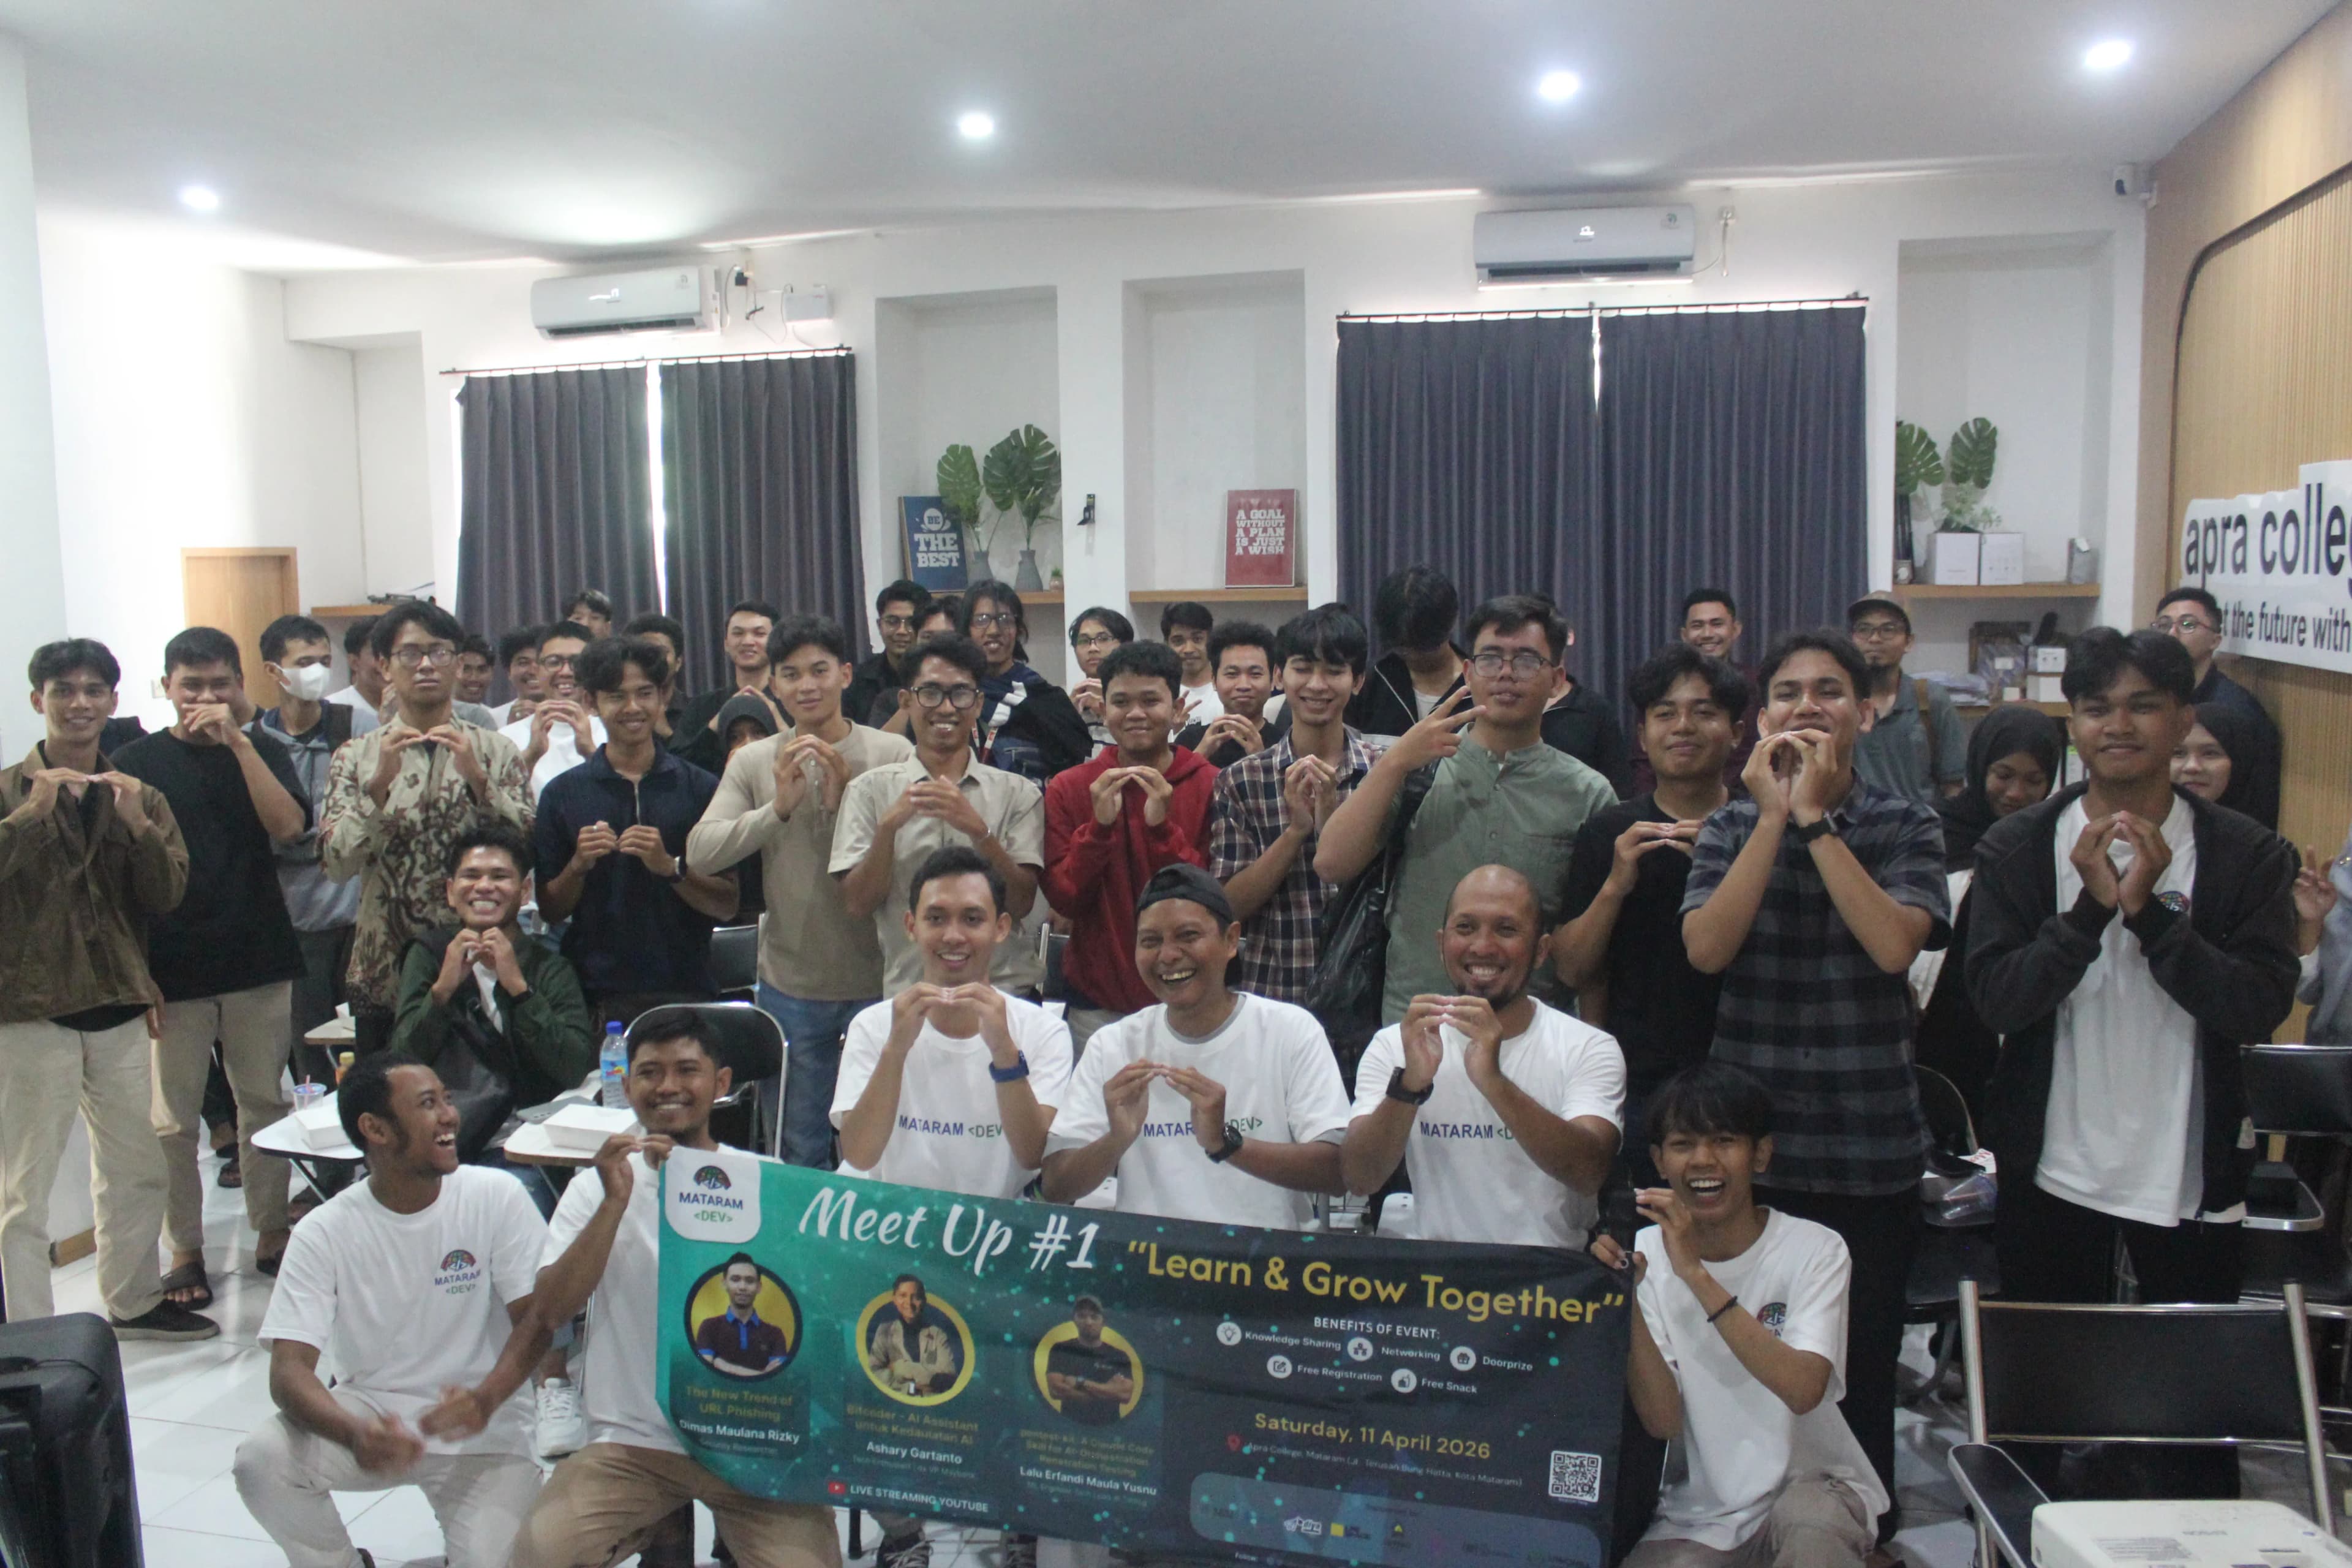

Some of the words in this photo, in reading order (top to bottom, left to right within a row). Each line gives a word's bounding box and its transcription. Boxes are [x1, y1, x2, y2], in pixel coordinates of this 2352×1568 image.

[927, 516, 940, 524] BE
[1236, 510, 1246, 519] A
[1250, 509, 1285, 519] GOAL
[1235, 528, 1245, 537] A
[1250, 527, 1285, 537] PLAN
[2185, 513, 2247, 589] apra
[2260, 483, 2352, 599] colle
[914, 533, 959, 552] THE
[1236, 537, 1248, 546] IS
[1252, 537, 1285, 546] JUST
[916, 552, 960, 568] BEST
[1235, 546, 1244, 556] A
[1248, 546, 1284, 556] WISH
[2232, 600, 2254, 639] the
[2259, 601, 2307, 647] future
[2313, 607, 2351, 654] with
[899, 1115, 963, 1136] MATARAM
[1144, 1122, 1195, 1137] MATAR
[1420, 1121, 1493, 1139] MATARAM
[679, 1192, 743, 1210] MATARAM
[693, 1210, 733, 1223] <DEV>
[799, 1187, 927, 1248] Meet
[943, 1204, 1012, 1276] Up
[1029, 1213, 1099, 1271] #1
[1264, 1256, 1289, 1291] &
[1302, 1262, 1407, 1303] Grow
[1314, 1316, 1373, 1333] BENEFITS
[1376, 1323, 1392, 1335] OF
[1396, 1324, 1440, 1340] EVENT:
[1245, 1332, 1300, 1346] Knowledge
[1303, 1338, 1341, 1351] Sharing
[1381, 1346, 1441, 1362] Networking
[1483, 1355, 1533, 1371] Doorprize
[1297, 1365, 1320, 1376] Free
[1322, 1367, 1382, 1382] Registration
[1422, 1378, 1444, 1390] Free
[1446, 1382, 1477, 1394] Snack
[680, 1420, 714, 1434] Dimas
[716, 1424, 765, 1439] Maulana
[768, 1430, 799, 1445] Rizky
[1255, 1413, 1354, 1444] Saturday,
[1360, 1427, 1374, 1443] 11
[1381, 1430, 1431, 1452] April
[1436, 1438, 1491, 1459] 2026
[867, 1441, 907, 1458] Ashary
[910, 1447, 963, 1464] Gartanto
[1020, 1466, 1042, 1479] Lalu
[1045, 1470, 1084, 1485] Erfandi
[1087, 1476, 1119, 1490] Maula
[1122, 1481, 1157, 1496] Yusnu
[850, 1485, 872, 1496] LIVE
[875, 1488, 937, 1505] STREAMING
[938, 1497, 989, 1513] YOUTUBE
